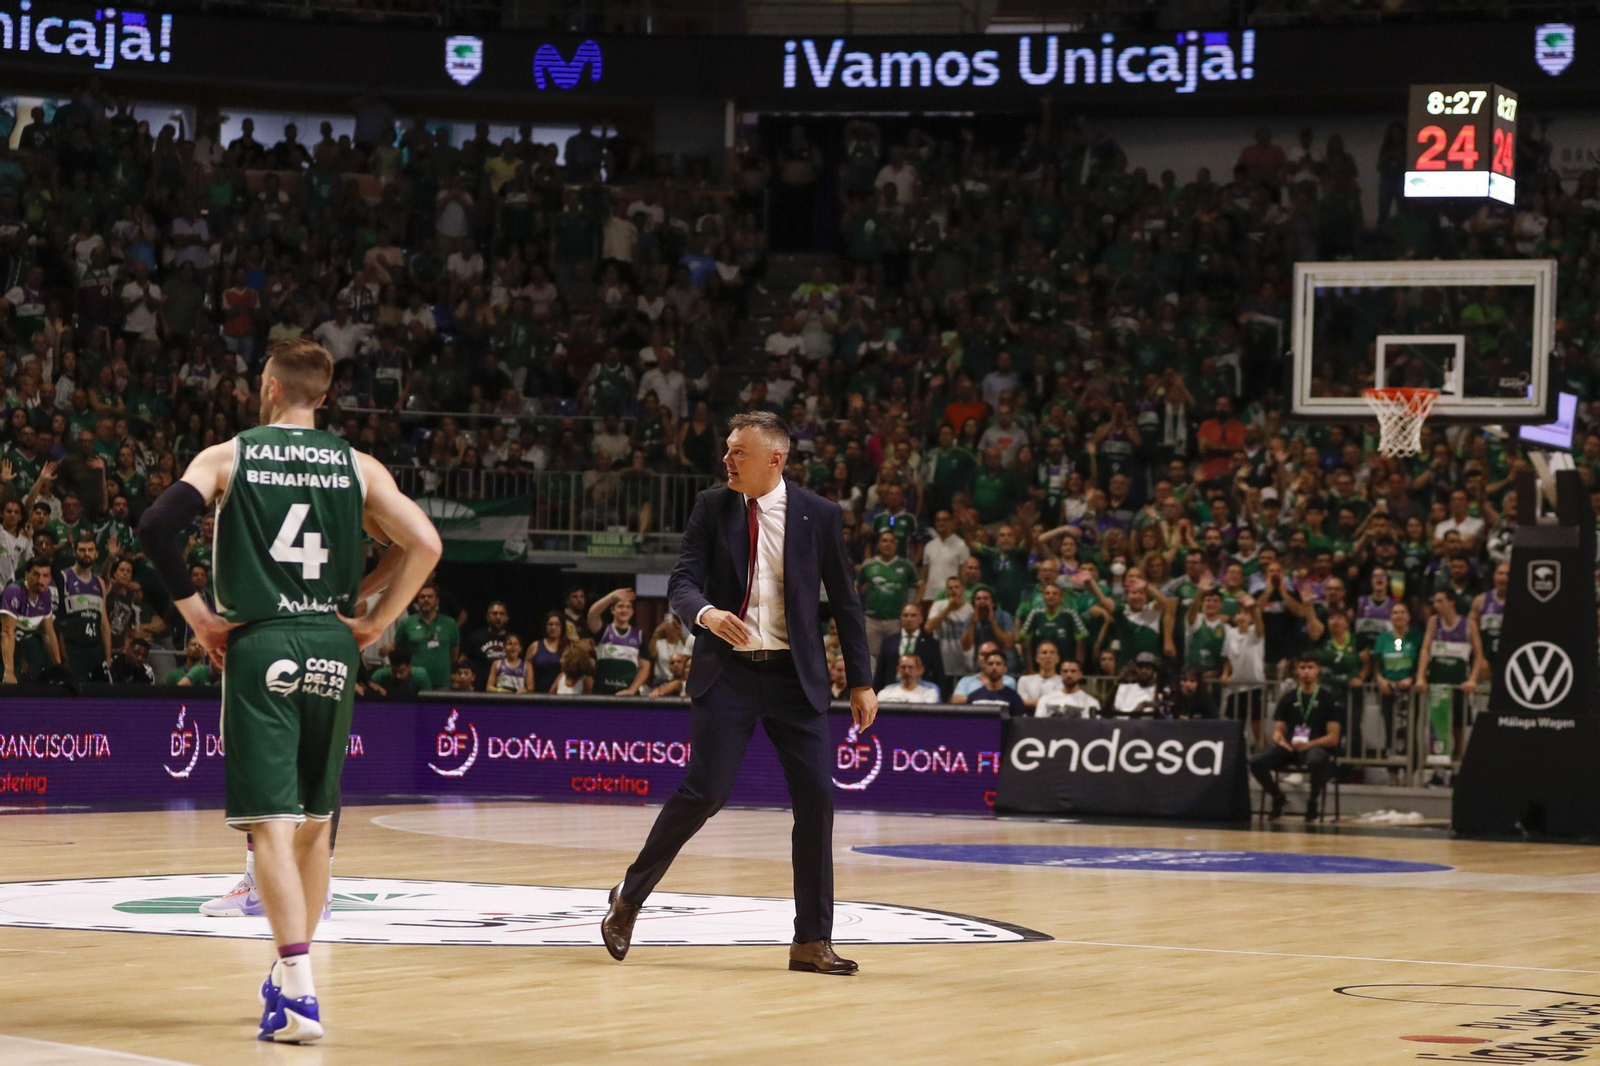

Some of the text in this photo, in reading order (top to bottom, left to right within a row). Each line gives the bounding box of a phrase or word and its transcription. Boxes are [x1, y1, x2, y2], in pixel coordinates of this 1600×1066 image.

[1018, 29, 1256, 93] Unicaja!
[1426, 90, 1487, 115] 8:27
[1415, 124, 1479, 170] 24
[1492, 127, 1514, 177] 24
[245, 444, 348, 466] KALINOSKI
[246, 470, 351, 488] BENAHAVÍS
[268, 503, 329, 580] 4
[304, 672, 328, 685] DEL
[305, 657, 348, 679] COSTA
[488, 732, 557, 760] DOÑA
[893, 744, 969, 772] DOÑA
[1010, 729, 1224, 775] endesa
[571, 774, 649, 795] catering
